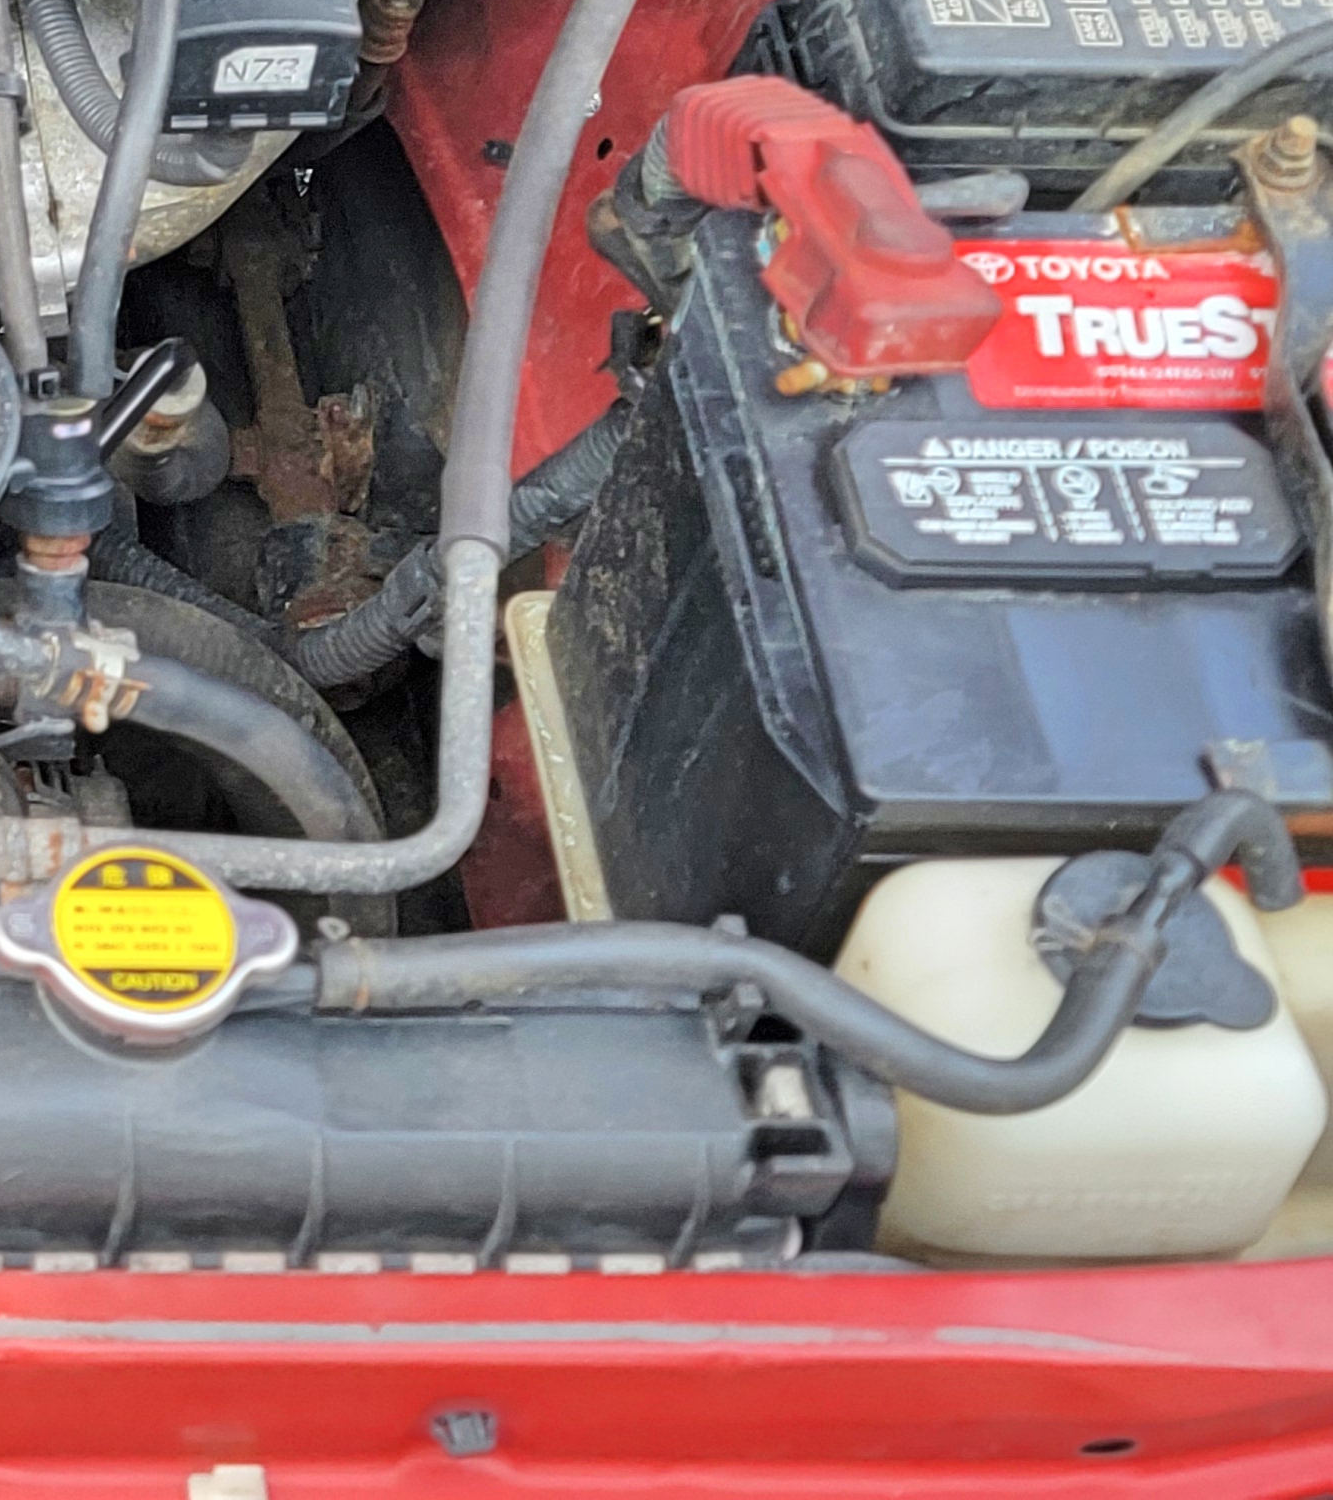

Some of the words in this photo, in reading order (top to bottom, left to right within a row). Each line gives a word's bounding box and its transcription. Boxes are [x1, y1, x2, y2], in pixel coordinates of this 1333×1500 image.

[223, 57, 301, 82] N73
[1017, 255, 1170, 281] TOYOTA
[949, 439, 1062, 458] DANGER
[1087, 439, 1189, 458] POISON
[110, 970, 200, 992] CAUTION
